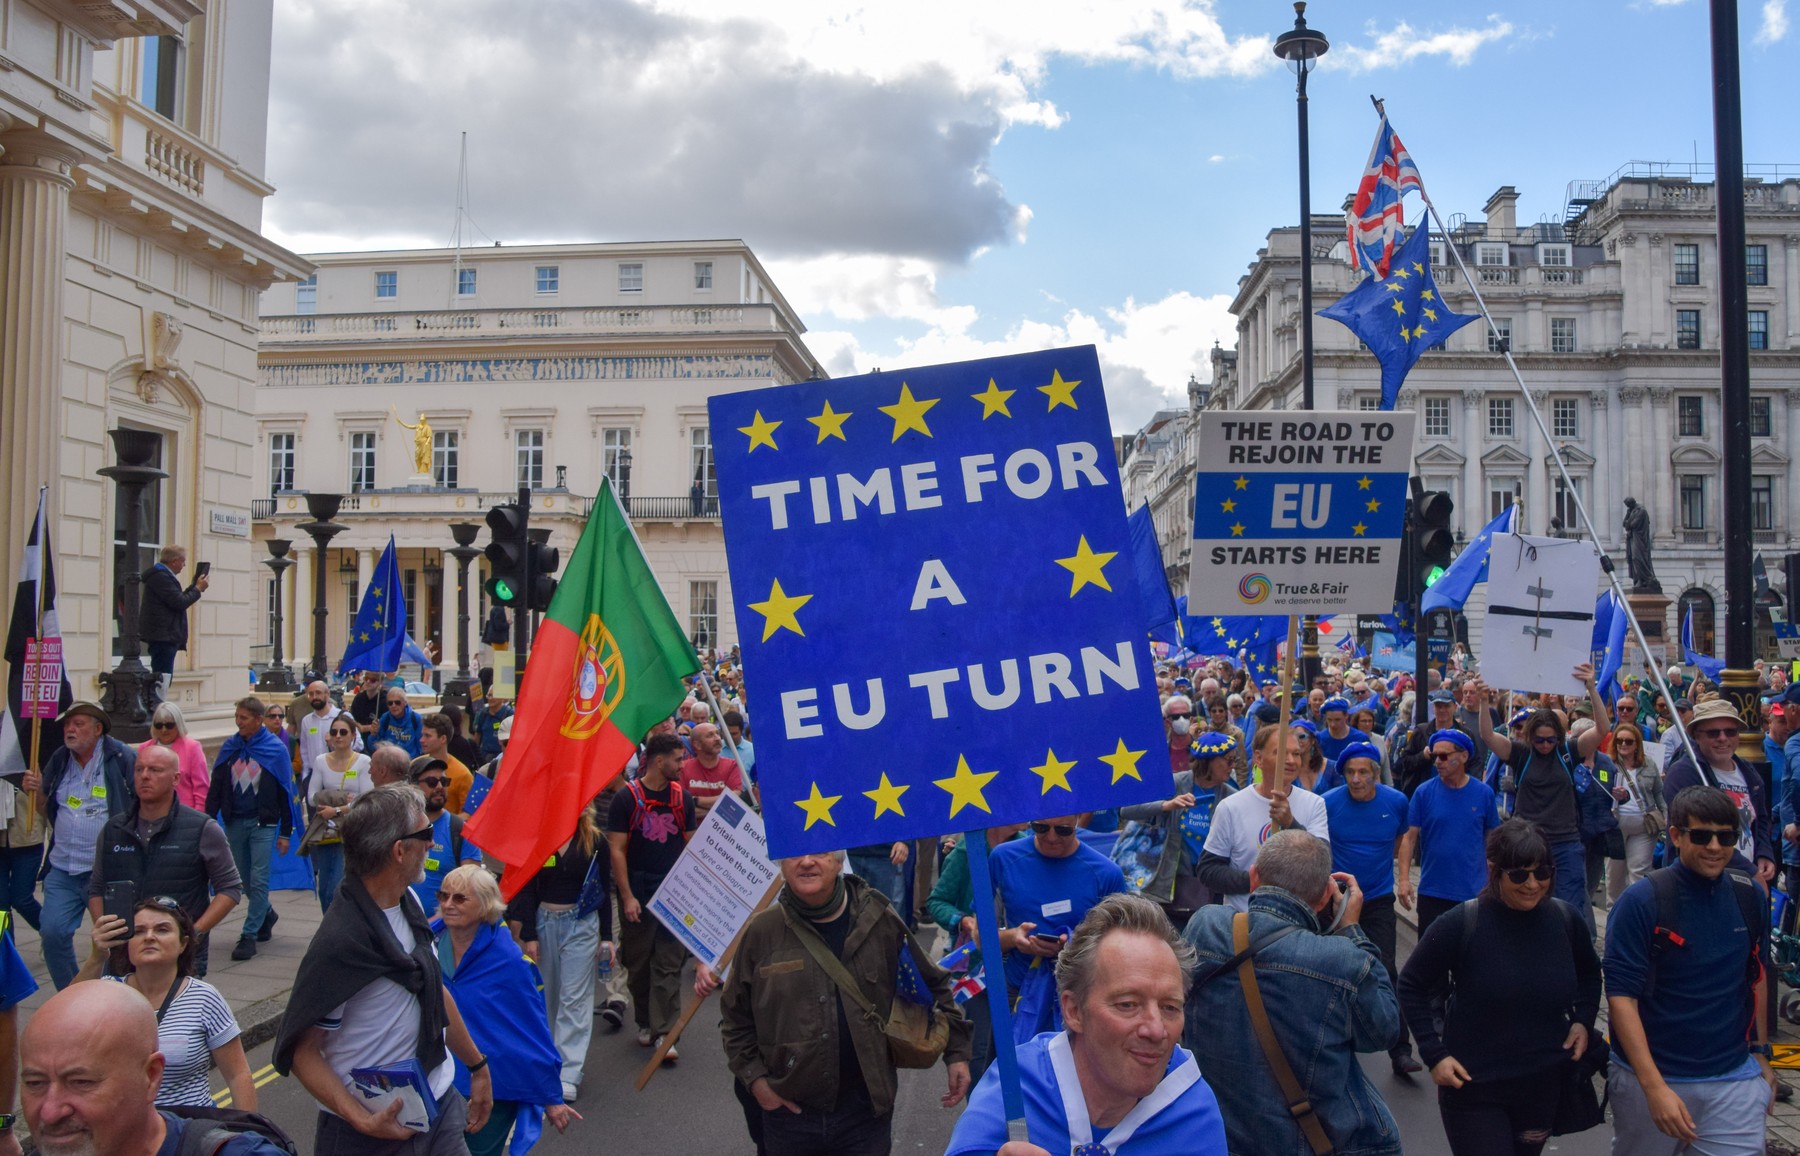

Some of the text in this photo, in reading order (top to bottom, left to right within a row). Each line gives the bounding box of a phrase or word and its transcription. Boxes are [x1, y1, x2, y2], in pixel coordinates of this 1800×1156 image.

[1221, 422, 1394, 441] THE ROAD TO
[1228, 445, 1383, 464] REJOIN THE
[751, 441, 1109, 530] TIME FOR
[214, 513, 225, 523] PALL
[225, 515, 237, 525] MALL
[1271, 483, 1332, 529] EU
[1211, 546, 1381, 565] STARTS HERE
[909, 559, 968, 611] A
[1288, 597, 1321, 605] deserve
[1323, 597, 1347, 605] better
[28, 643, 61, 653] TOES OUT
[25, 665, 60, 680] REOIN
[780, 641, 1140, 740] EU TURN
[43, 685, 57, 701] EU
[742, 821, 767, 846] Brexit
[1188, 812, 1203, 820] Bath
[698, 848, 716, 865] Agree
[721, 868, 752, 896] Disagree?
[705, 835, 714, 845] to
[713, 842, 734, 863] Leave
[733, 860, 746, 875] the
[735, 842, 749, 858] was
[749, 855, 773, 880] wrong
[673, 874, 688, 890] Britain
[688, 888, 699, 901] have
[702, 903, 723, 924] majority
[722, 921, 735, 934] that
[684, 871, 716, 902] constituencies
[720, 905, 735, 920] Great
[692, 865, 737, 909] Question: How many
[665, 897, 683, 915] Answer:
[692, 924, 702, 934] out
[707, 937, 717, 947] 632
[672, 887, 680, 896] see
[679, 894, 694, 910] Brexit
[702, 917, 725, 937] mistake?
